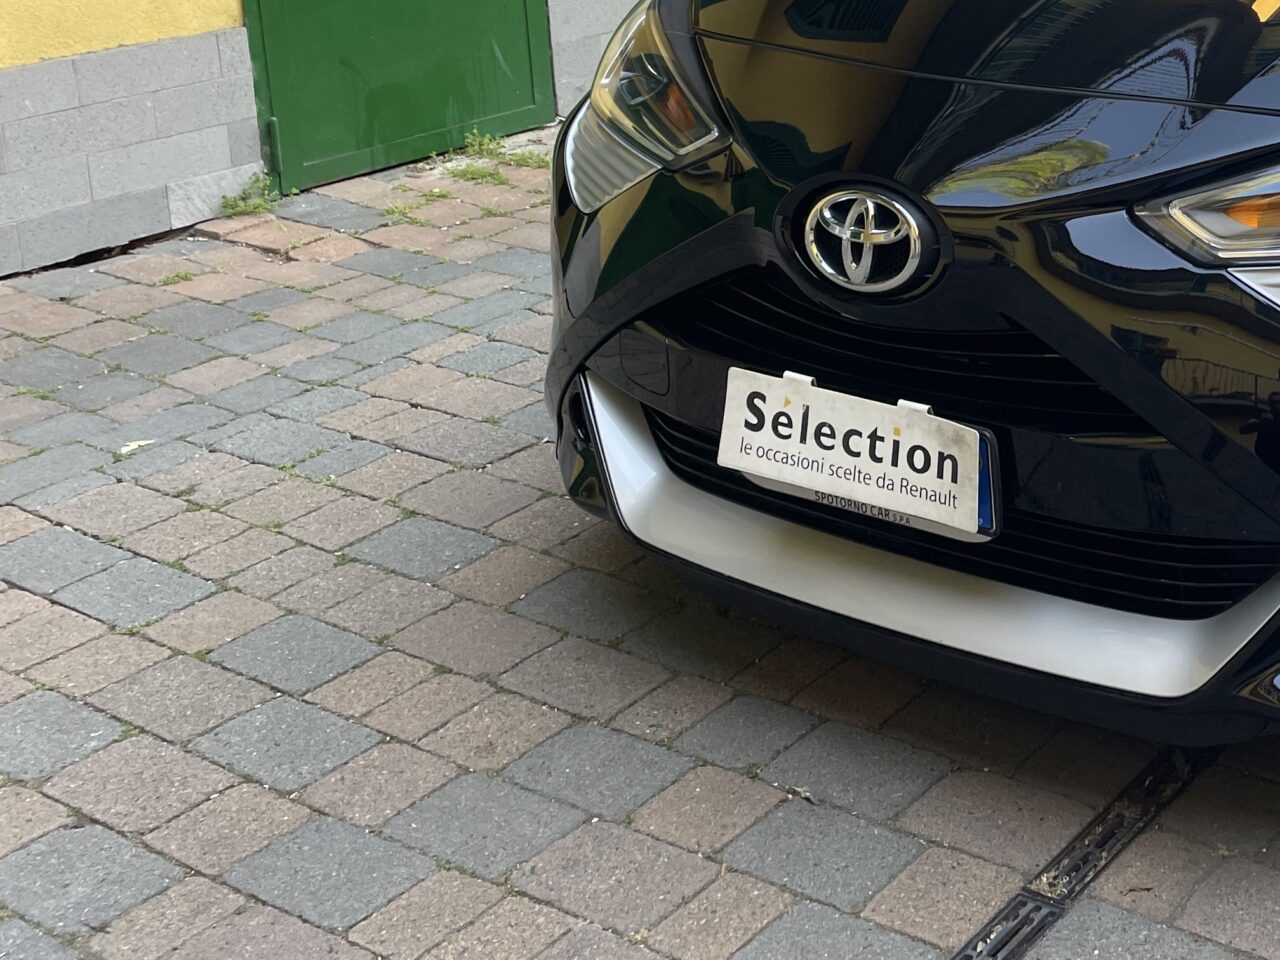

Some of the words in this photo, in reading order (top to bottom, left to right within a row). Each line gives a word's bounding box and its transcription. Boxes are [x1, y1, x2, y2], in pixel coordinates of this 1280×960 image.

[740, 436, 752, 455] le
[756, 446, 824, 474] occasioni
[828, 464, 872, 486] scelte
[876, 472, 895, 492] da
[900, 477, 958, 510] Renault
[814, 491, 867, 514] SPOTORNO
[870, 505, 890, 520] CAR
